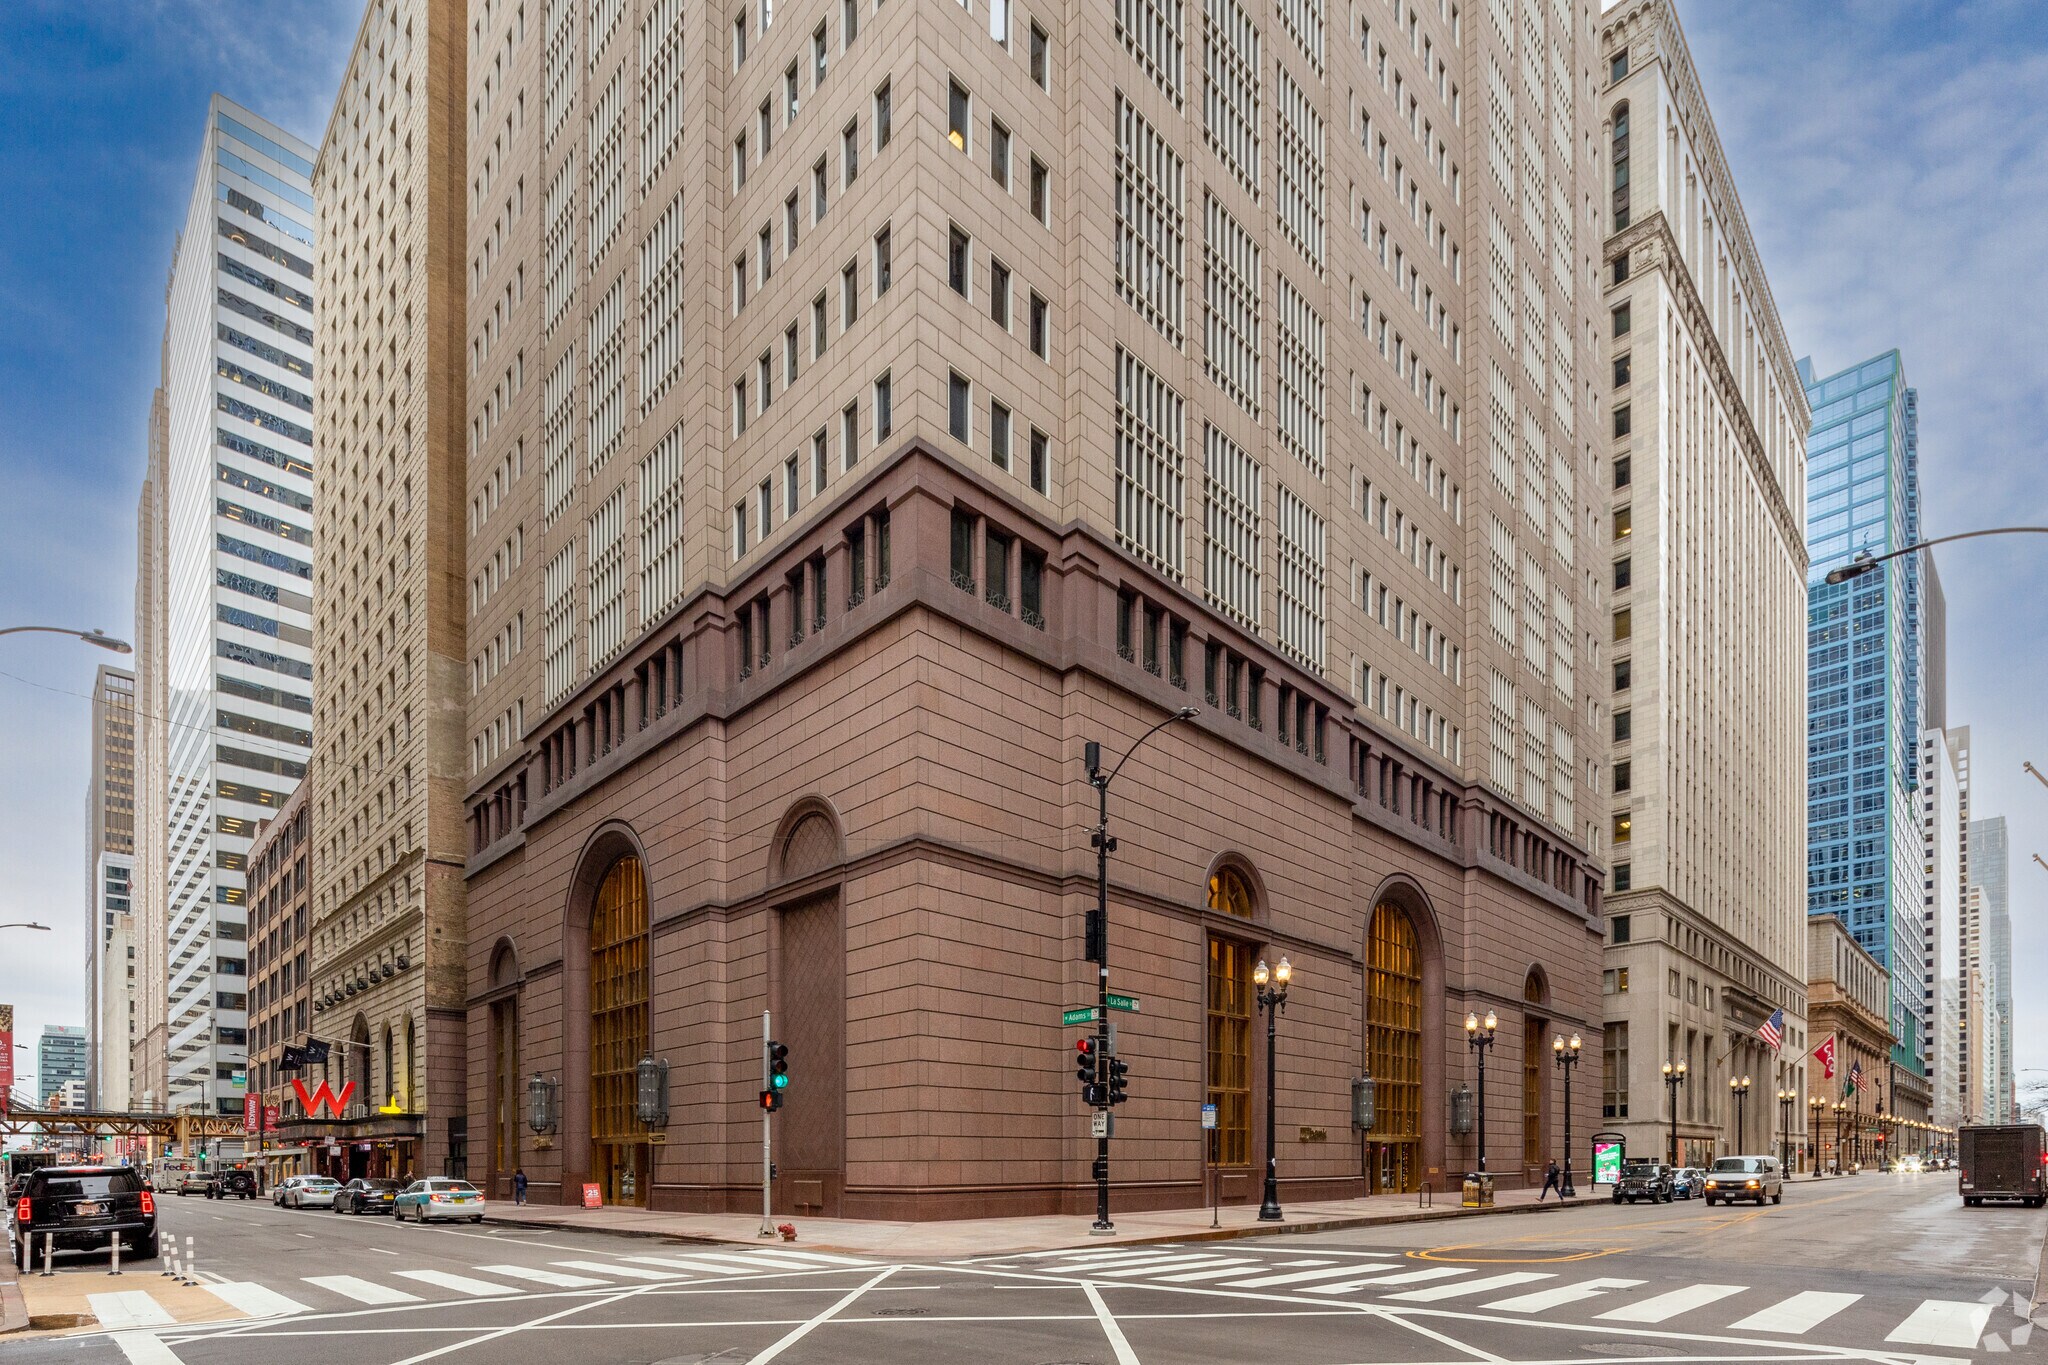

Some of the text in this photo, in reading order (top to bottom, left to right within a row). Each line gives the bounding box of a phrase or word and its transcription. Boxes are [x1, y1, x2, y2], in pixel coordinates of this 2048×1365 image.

[1110, 997, 1116, 1006] La
[1117, 998, 1129, 1008] Salle
[1068, 1013, 1086, 1021] Adams
[291, 1079, 357, 1118] W
[248, 1099, 256, 1127] AWAKEN
[163, 1162, 196, 1171] FedEx
